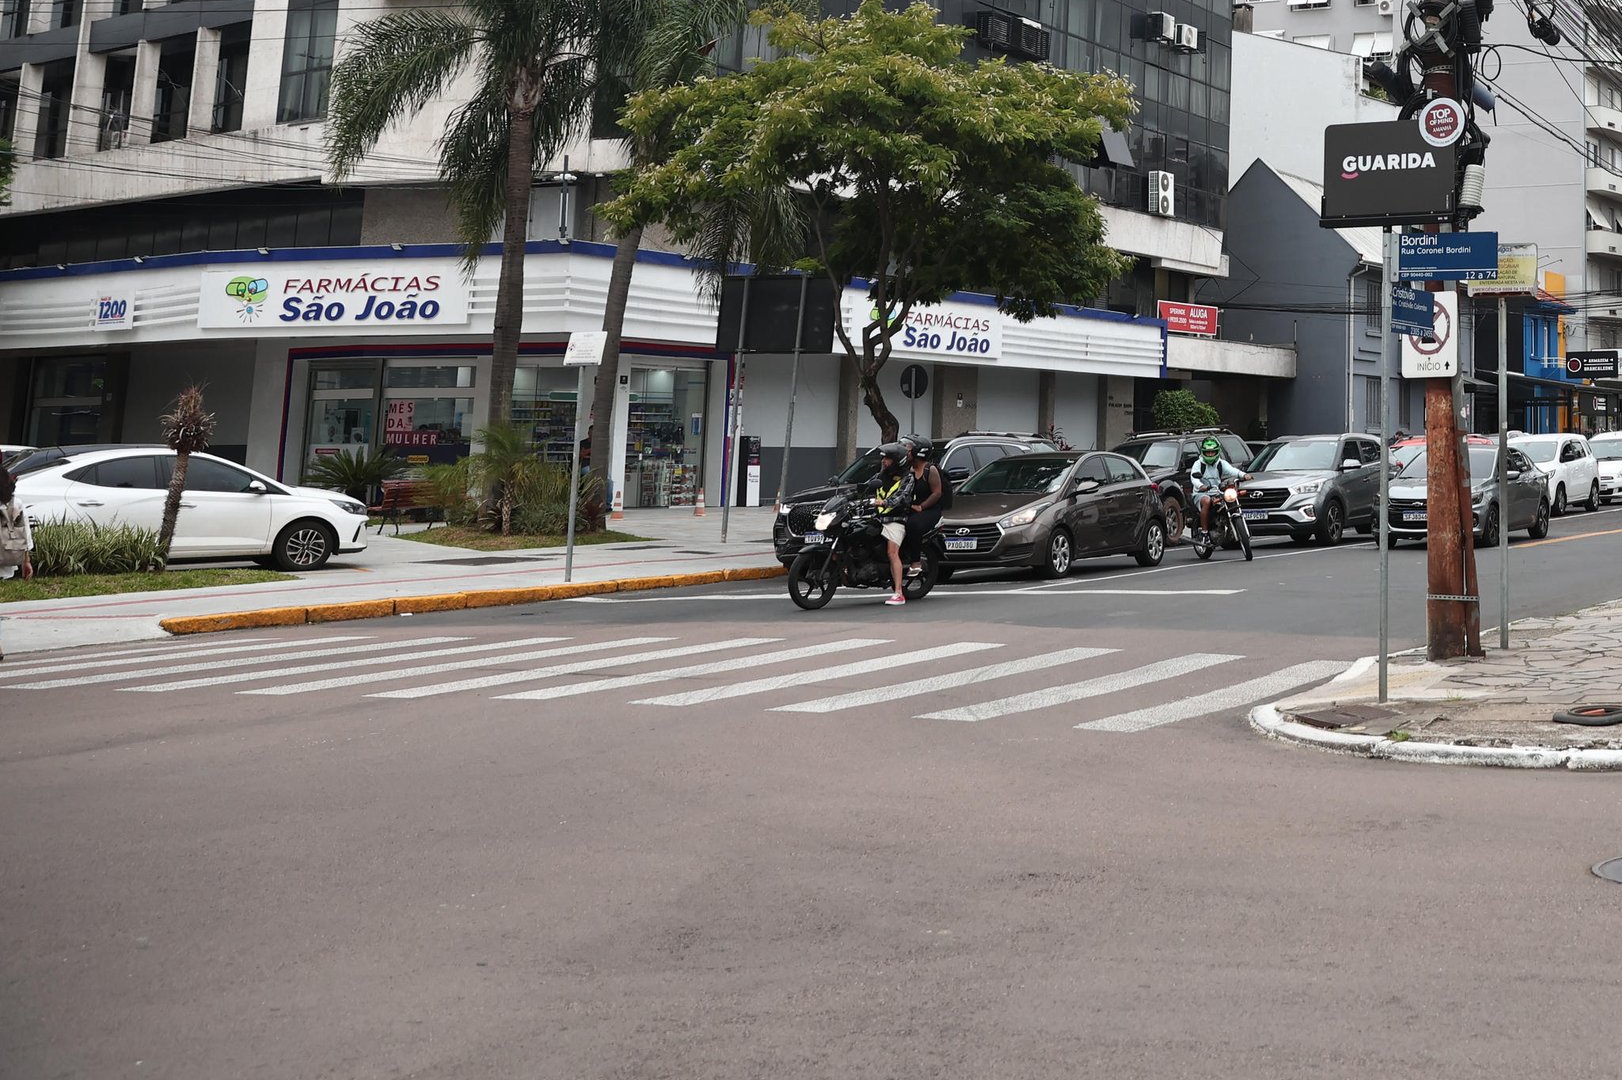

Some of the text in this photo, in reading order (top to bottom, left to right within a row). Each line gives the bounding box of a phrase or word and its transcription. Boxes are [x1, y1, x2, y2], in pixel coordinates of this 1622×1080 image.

[1430, 108, 1451, 120] TOP
[1438, 117, 1454, 125] MIND
[1342, 152, 1437, 172] GUARIDA
[1401, 235, 1438, 246] Bordini
[1446, 246, 1472, 254] Bordini
[1486, 271, 1497, 279] 74
[283, 273, 441, 294] FARMÁCIAS
[99, 300, 127, 319] 1200
[279, 293, 440, 321] São João
[1190, 308, 1208, 319] ALUGA
[904, 311, 990, 331] FARMÁCIAS
[903, 326, 990, 354] São João
[1417, 361, 1440, 371] INÍCIO
[388, 401, 414, 413] MÊS
[388, 418, 404, 428] DA
[386, 433, 437, 445] MULHER
